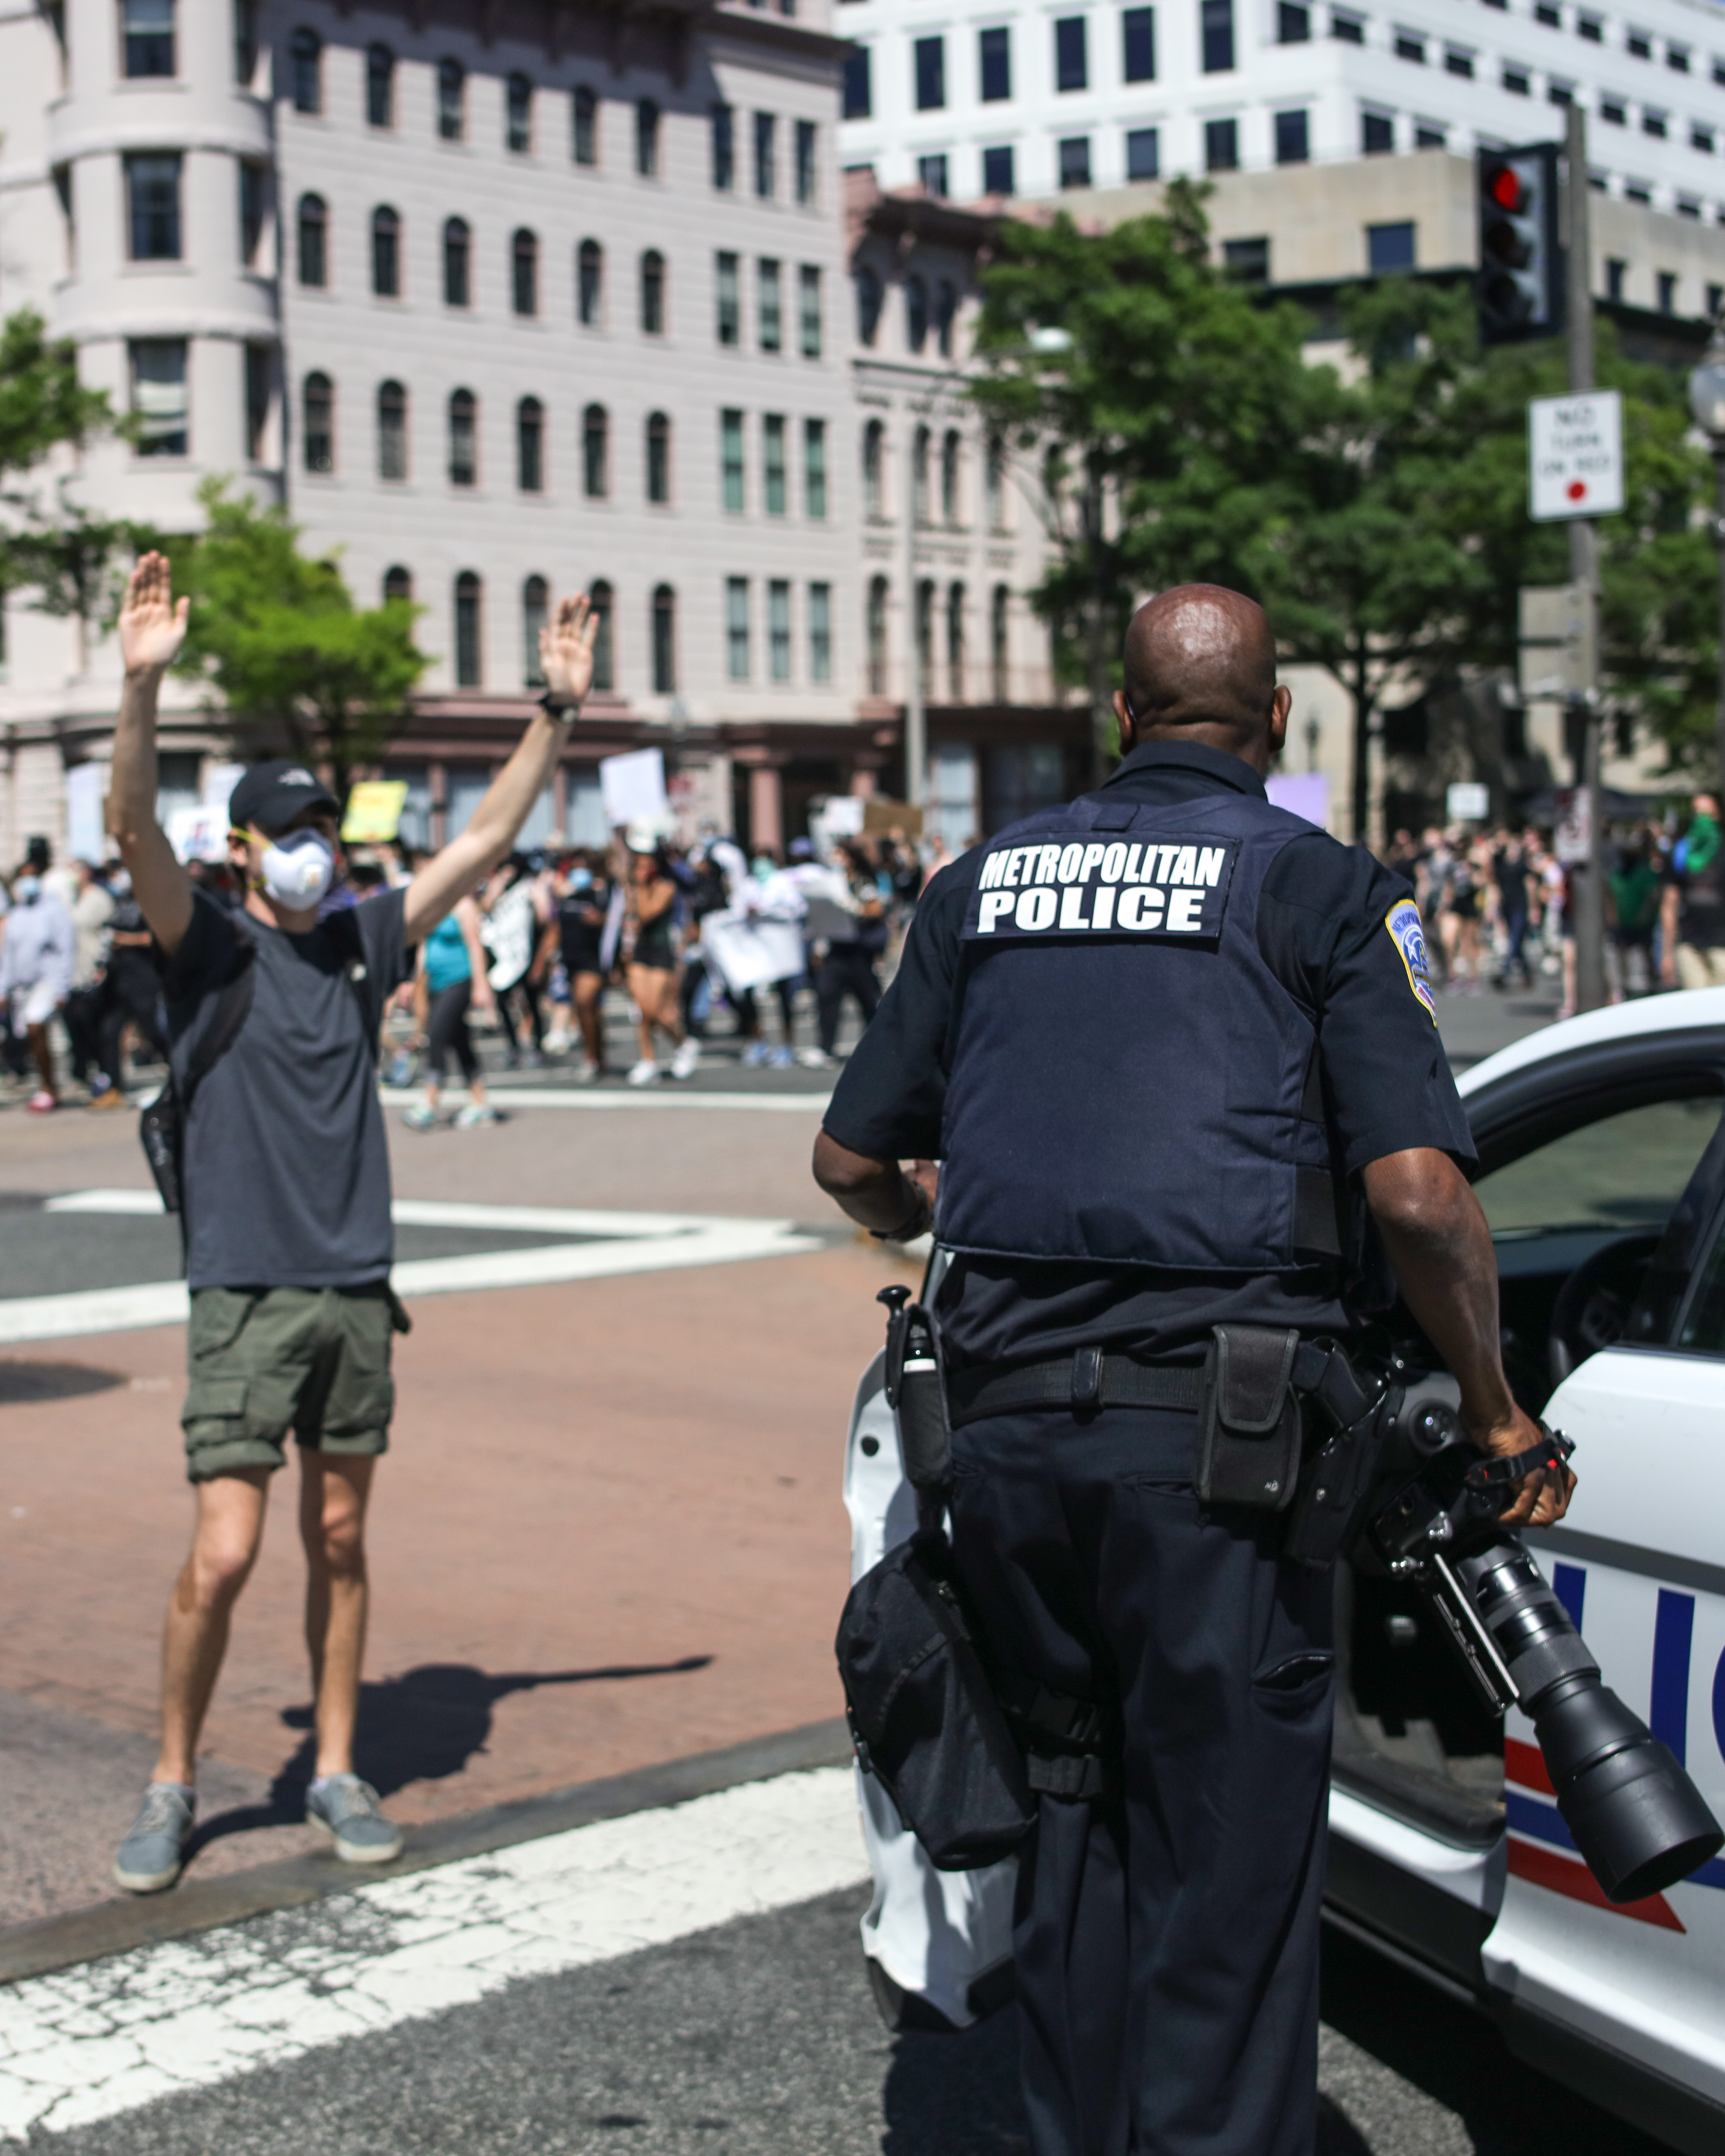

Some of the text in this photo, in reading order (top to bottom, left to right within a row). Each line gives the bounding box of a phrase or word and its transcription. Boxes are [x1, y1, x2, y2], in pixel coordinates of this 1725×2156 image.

[1553, 402, 1597, 428] NO
[978, 842, 1226, 890] METROPOLITAN
[977, 886, 1206, 933] POLICE
